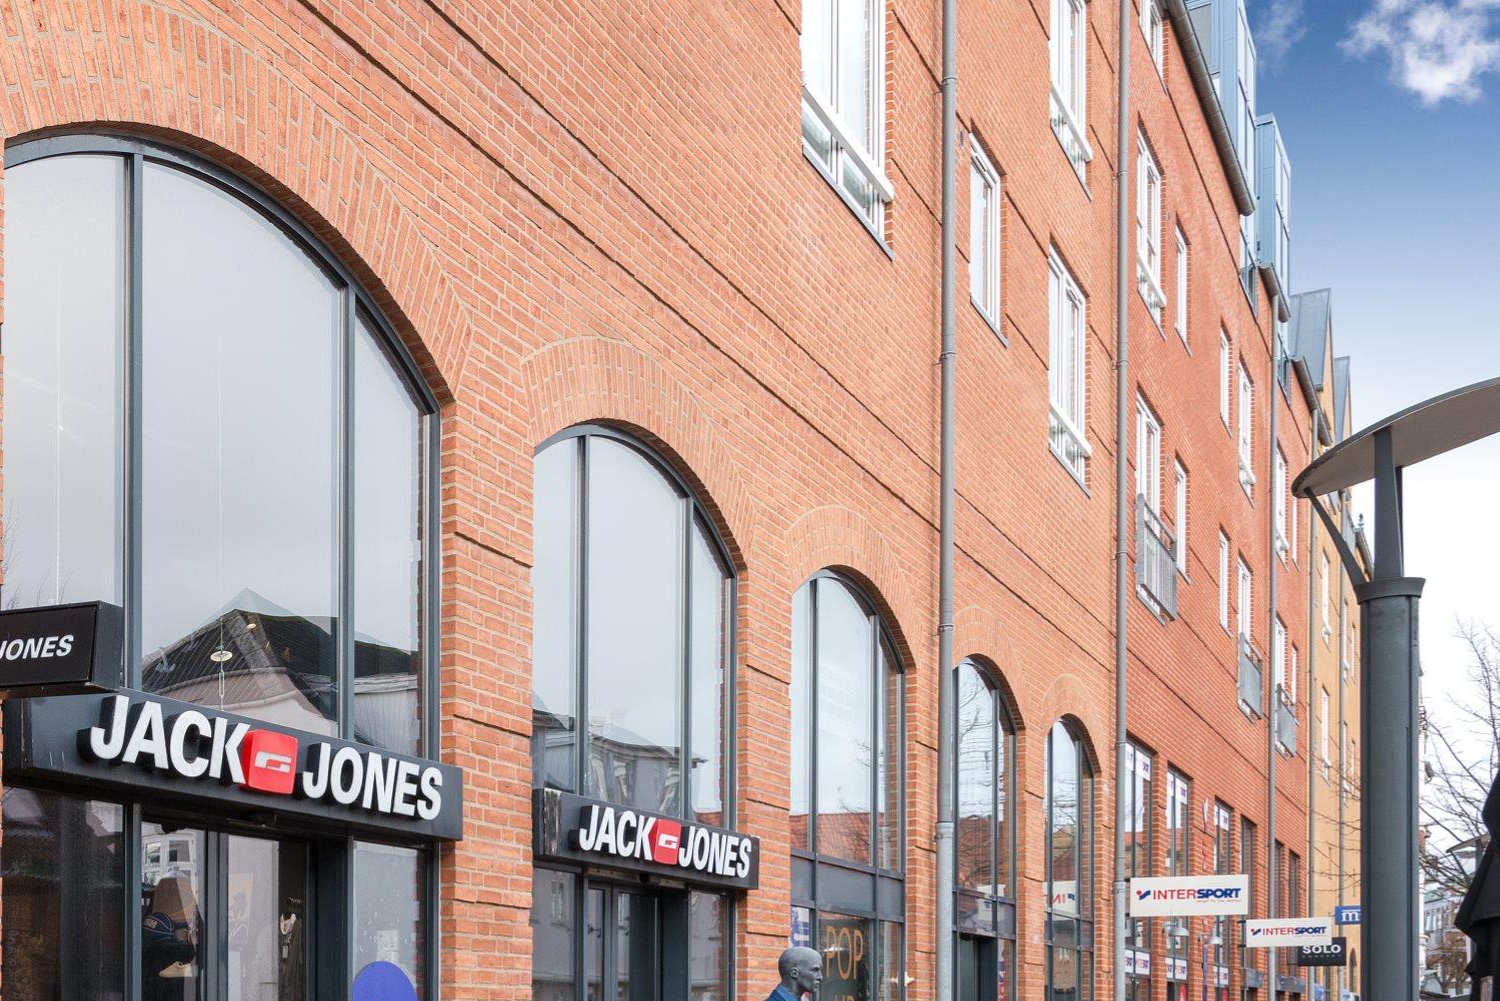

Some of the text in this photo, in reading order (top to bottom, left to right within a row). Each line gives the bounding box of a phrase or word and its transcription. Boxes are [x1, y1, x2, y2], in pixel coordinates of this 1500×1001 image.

[90, 694, 443, 821] JACK JONES
[579, 804, 752, 879] JACK JONES
[1153, 887, 1241, 900] INTERSPORT
[1262, 926, 1327, 936] INTERSPORT
[826, 925, 864, 981] POP
[1302, 944, 1341, 954] SOLO
